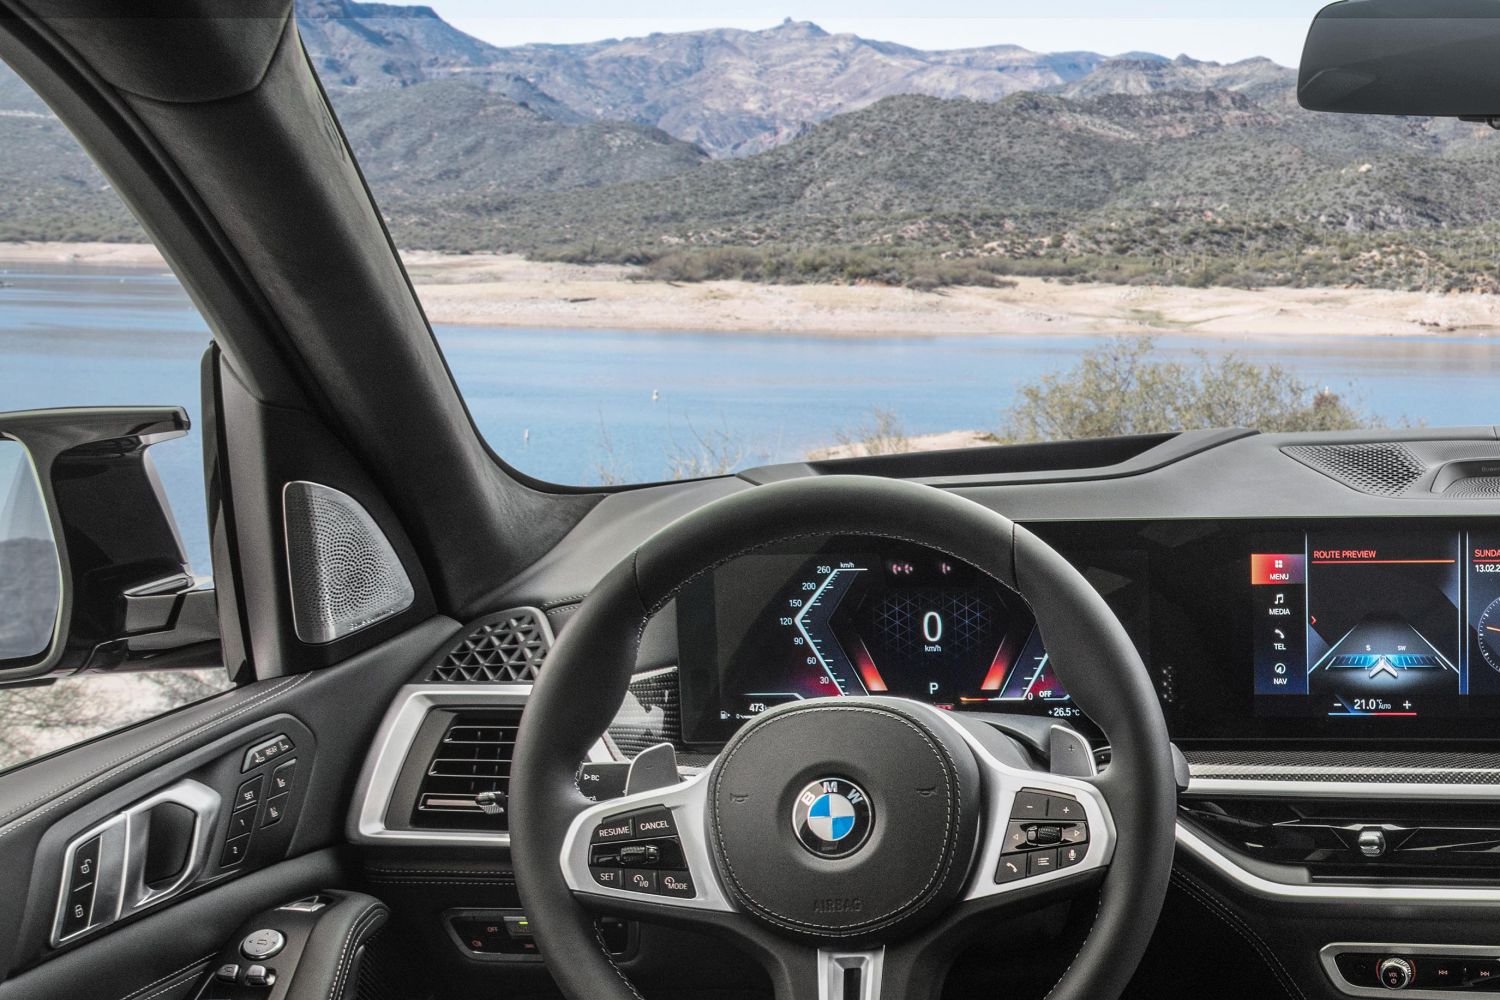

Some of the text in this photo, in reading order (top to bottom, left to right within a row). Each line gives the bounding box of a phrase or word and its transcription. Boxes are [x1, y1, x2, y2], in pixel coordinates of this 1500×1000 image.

[1313, 550, 1377, 558] ROUTE PREVIEW
[802, 582, 816, 590] 200
[789, 599, 802, 607] 150
[780, 617, 793, 625] 120
[923, 611, 942, 642] 0
[793, 637, 804, 645] 90
[924, 644, 942, 652] km/h
[807, 657, 817, 665] 60
[819, 676, 829, 684] 30
[929, 682, 939, 694] P
[749, 703, 764, 711] 473
[1354, 699, 1376, 709] 21.0
[801, 781, 863, 806] BMW
[640, 820, 670, 831] CANCEL
[599, 825, 631, 838] RESUME
[233, 846, 238, 854] 2
[600, 872, 615, 881] SET
